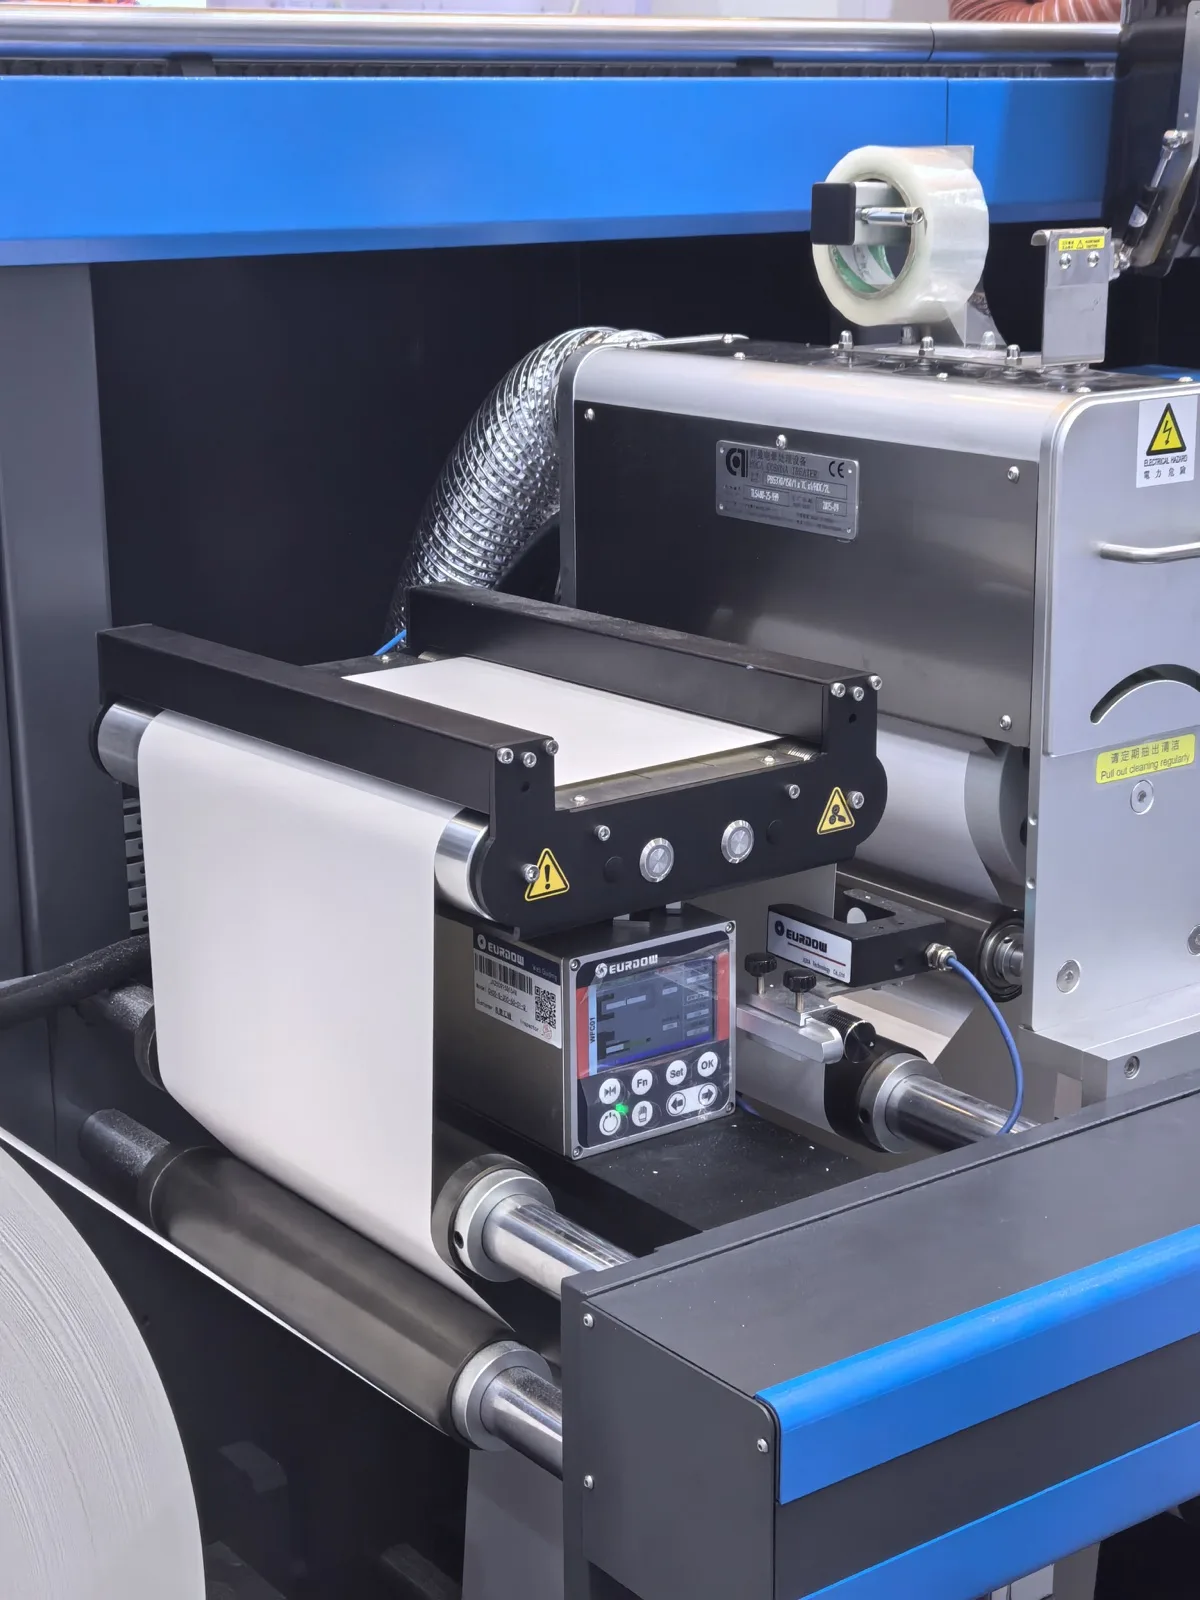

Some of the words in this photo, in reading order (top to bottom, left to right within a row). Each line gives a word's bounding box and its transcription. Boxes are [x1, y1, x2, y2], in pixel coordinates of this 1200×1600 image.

[1143, 457, 1170, 467] ELECTRICAL
[1170, 455, 1188, 465] HAZARD
[1100, 769, 1115, 780] Pull
[1116, 767, 1128, 777] out
[1129, 760, 1159, 774] cleaning
[1160, 752, 1191, 768] regularly
[785, 928, 828, 954] EURDOW
[487, 942, 526, 967] EURDOW
[609, 954, 659, 974] EURDOW
[701, 1058, 714, 1071] OK
[669, 1069, 684, 1079] Set
[636, 1078, 648, 1088] Fn
